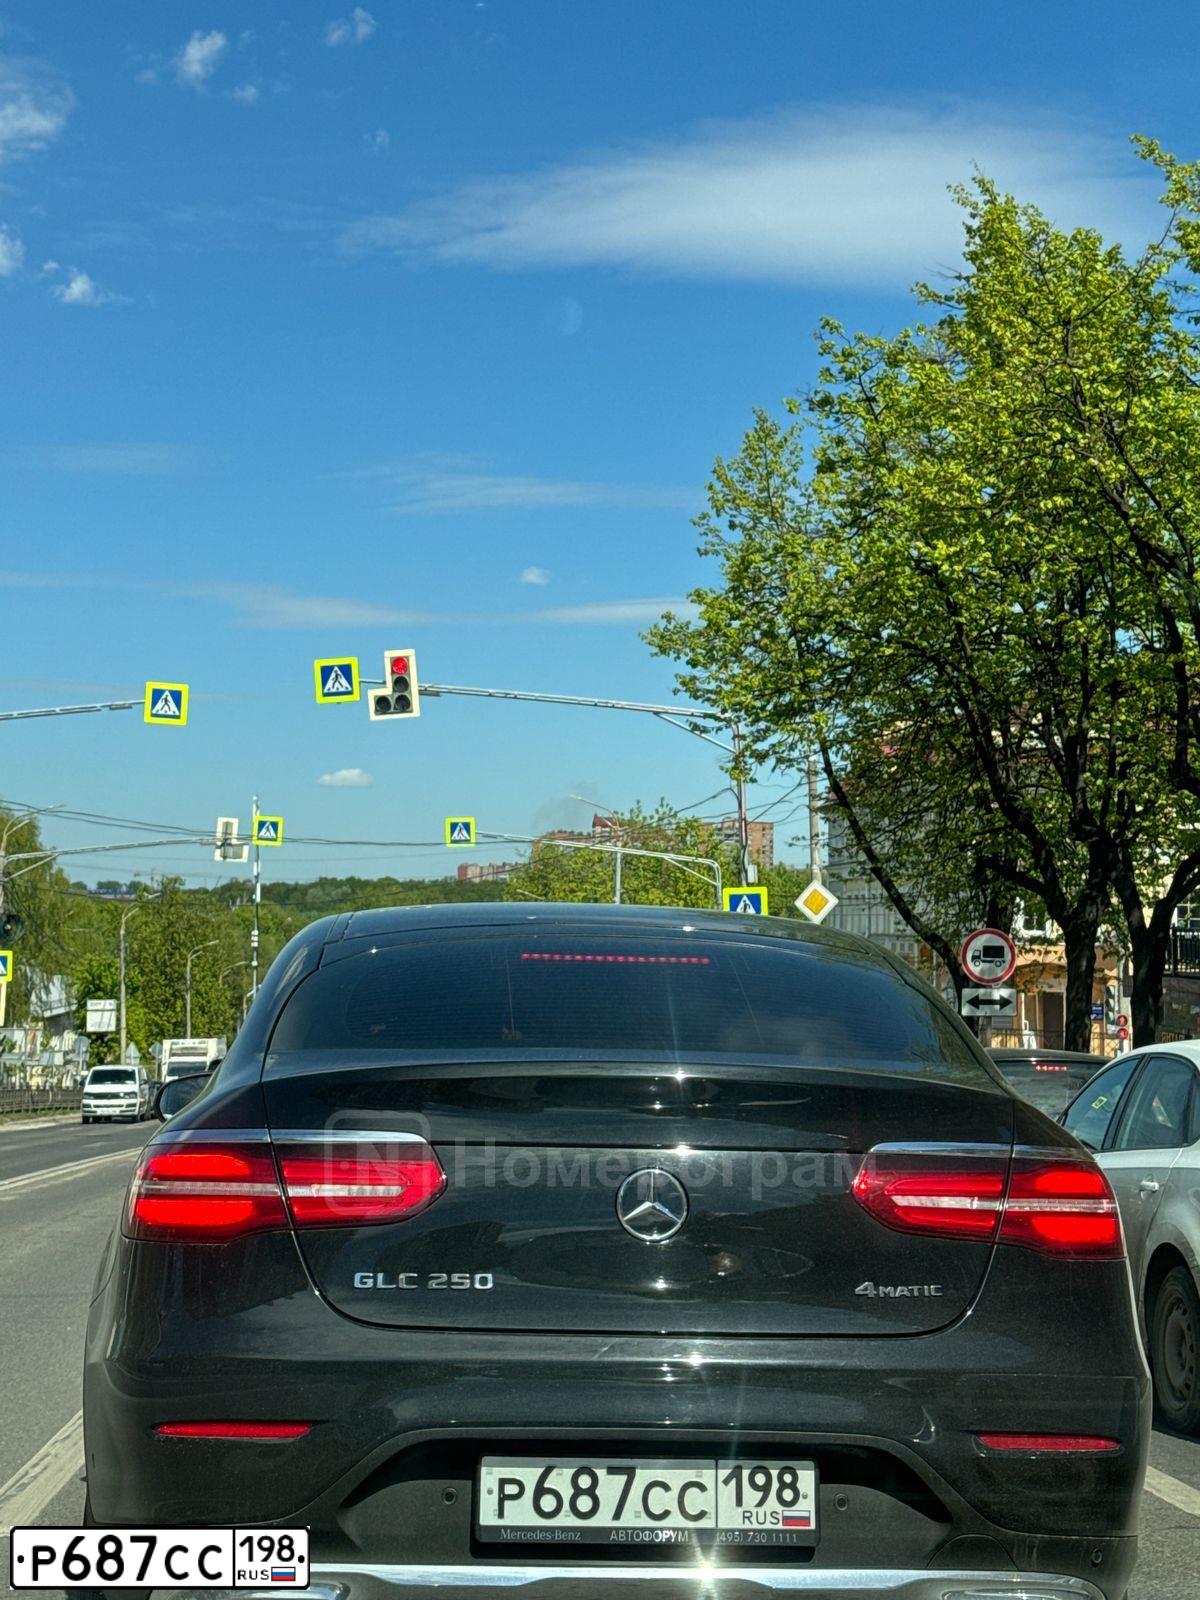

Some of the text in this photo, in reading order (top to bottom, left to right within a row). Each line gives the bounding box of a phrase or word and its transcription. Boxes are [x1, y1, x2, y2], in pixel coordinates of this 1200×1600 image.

[354, 1272, 494, 1290] GLC 250
[854, 1281, 943, 1298] 4MATIC
[497, 1464, 800, 1522] Р687СС 198
[742, 1510, 780, 1525] RUS
[499, 1528, 798, 1544] Mercedes-Benz АВТОФОРУМ (495) 730 1111
